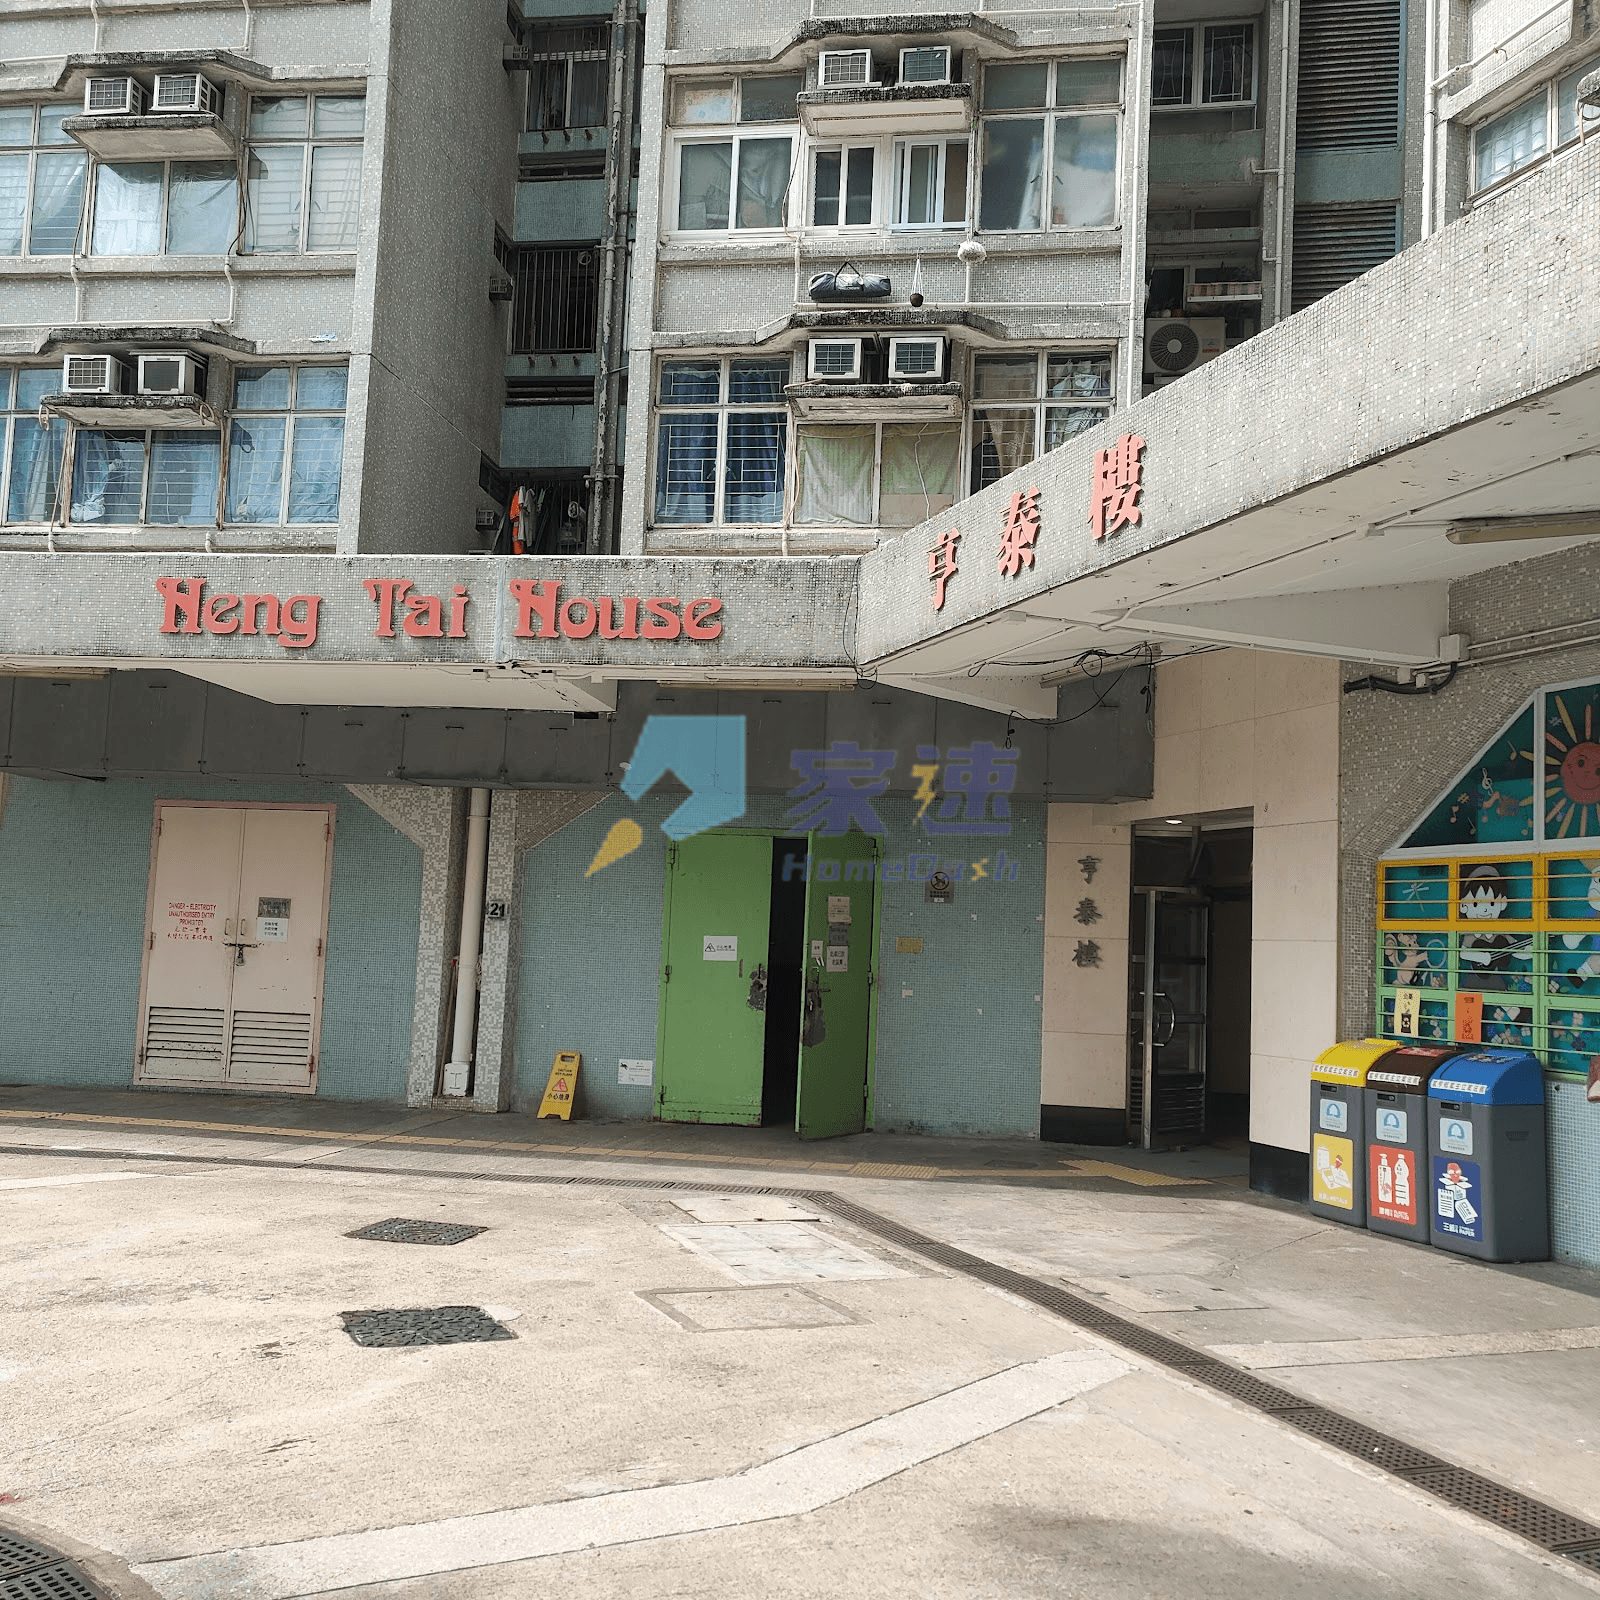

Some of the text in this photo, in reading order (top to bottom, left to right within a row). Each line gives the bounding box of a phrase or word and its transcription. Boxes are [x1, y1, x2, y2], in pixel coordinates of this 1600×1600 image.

[925, 434, 1146, 610] 亨泰樓
[155, 577, 722, 648] Heng Tai House
[168, 902, 186, 910] DANGER
[190, 903, 217, 912] ELECTRICITY
[490, 902, 506, 917] 21
[1072, 855, 1104, 969] 亨泰樓
